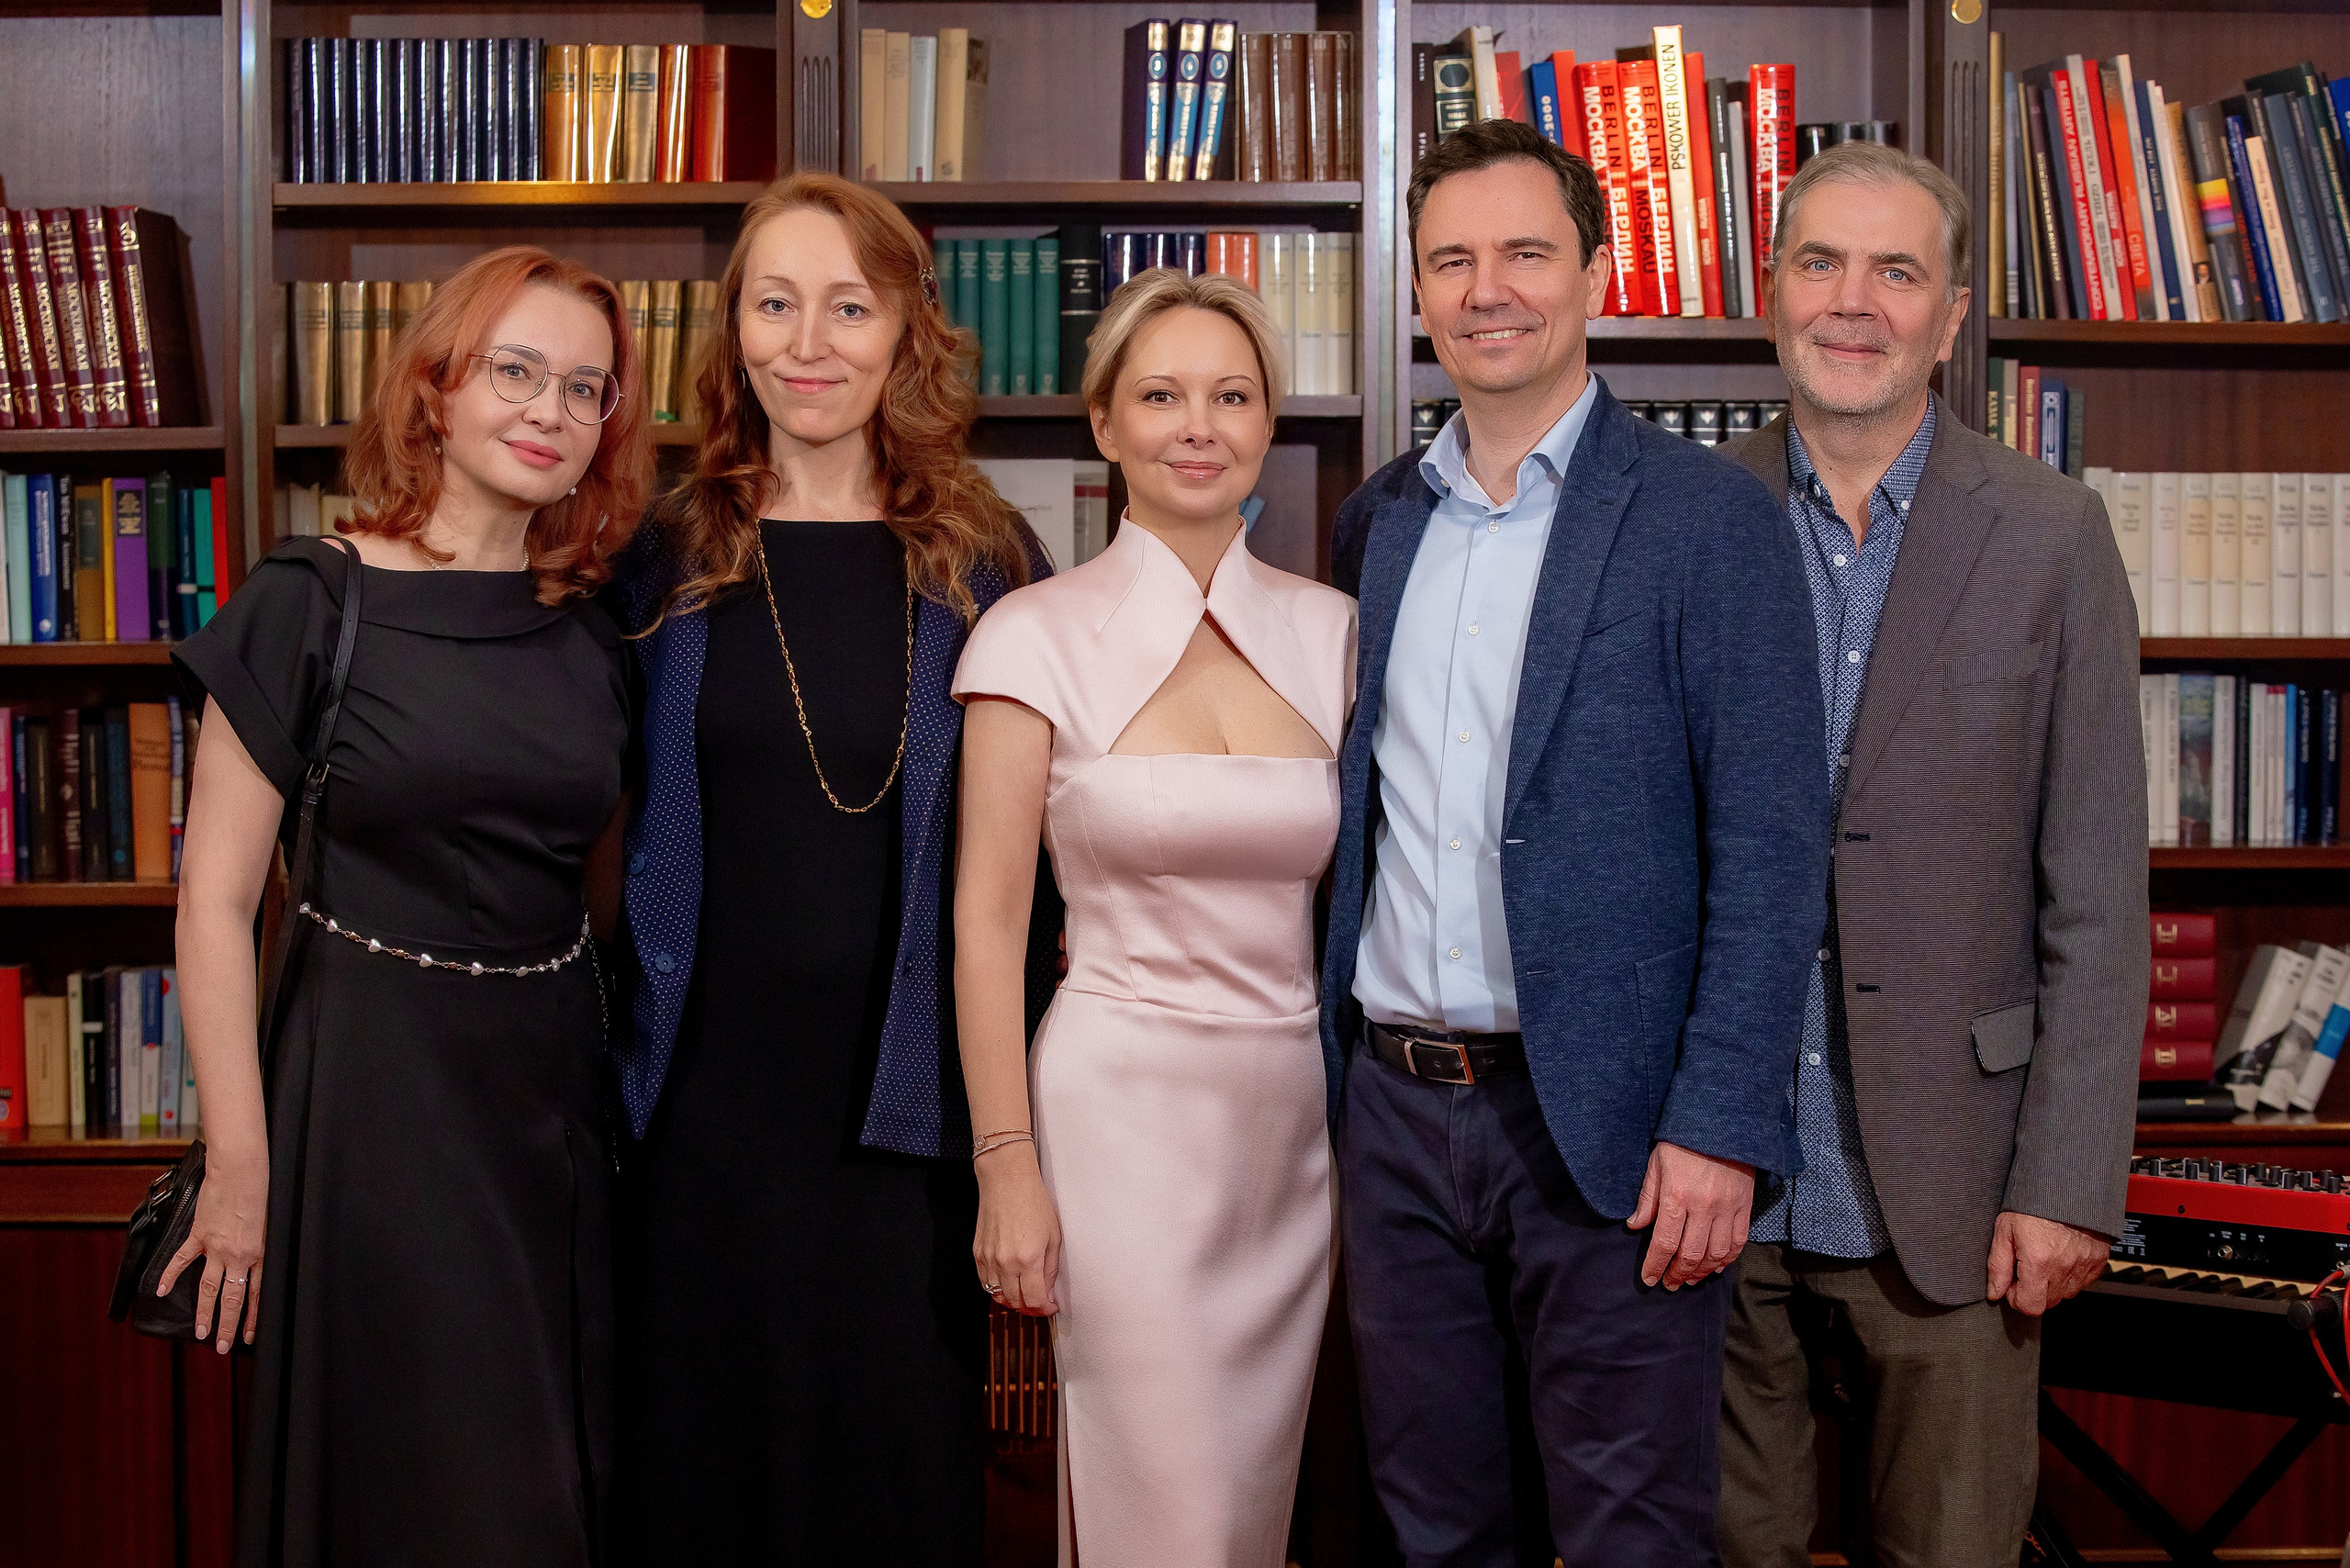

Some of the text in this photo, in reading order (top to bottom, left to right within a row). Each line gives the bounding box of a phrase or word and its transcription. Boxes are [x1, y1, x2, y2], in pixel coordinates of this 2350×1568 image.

[1583, 86, 1607, 171] МОСКВА
[1602, 85, 1621, 167] BERLIN
[1624, 86, 1650, 172] МОСКВА
[1642, 86, 1662, 167] BERLIN
[1662, 44, 1688, 171] PSKOWER IKONEN
[1759, 88, 1774, 174] МОСКВА
[1777, 89, 1790, 172] BERLIN
[2057, 80, 2076, 136] ARTISTS
[2067, 140, 2085, 197] RUSSIAN
[1612, 187, 1635, 273] БЕРЛИН
[1635, 189, 1656, 274] MOSKAU
[1652, 187, 1674, 273] БЕРЛИН
[2076, 200, 2104, 310] CONTEMPORARY
[8, 282, 32, 371] МОСКОВСКАЯ
[36, 281, 60, 371] МОСКОВСКАЯ
[66, 281, 89, 371] МОСКОВСКАЯ
[98, 279, 120, 368] МОСКОВСКАЯ
